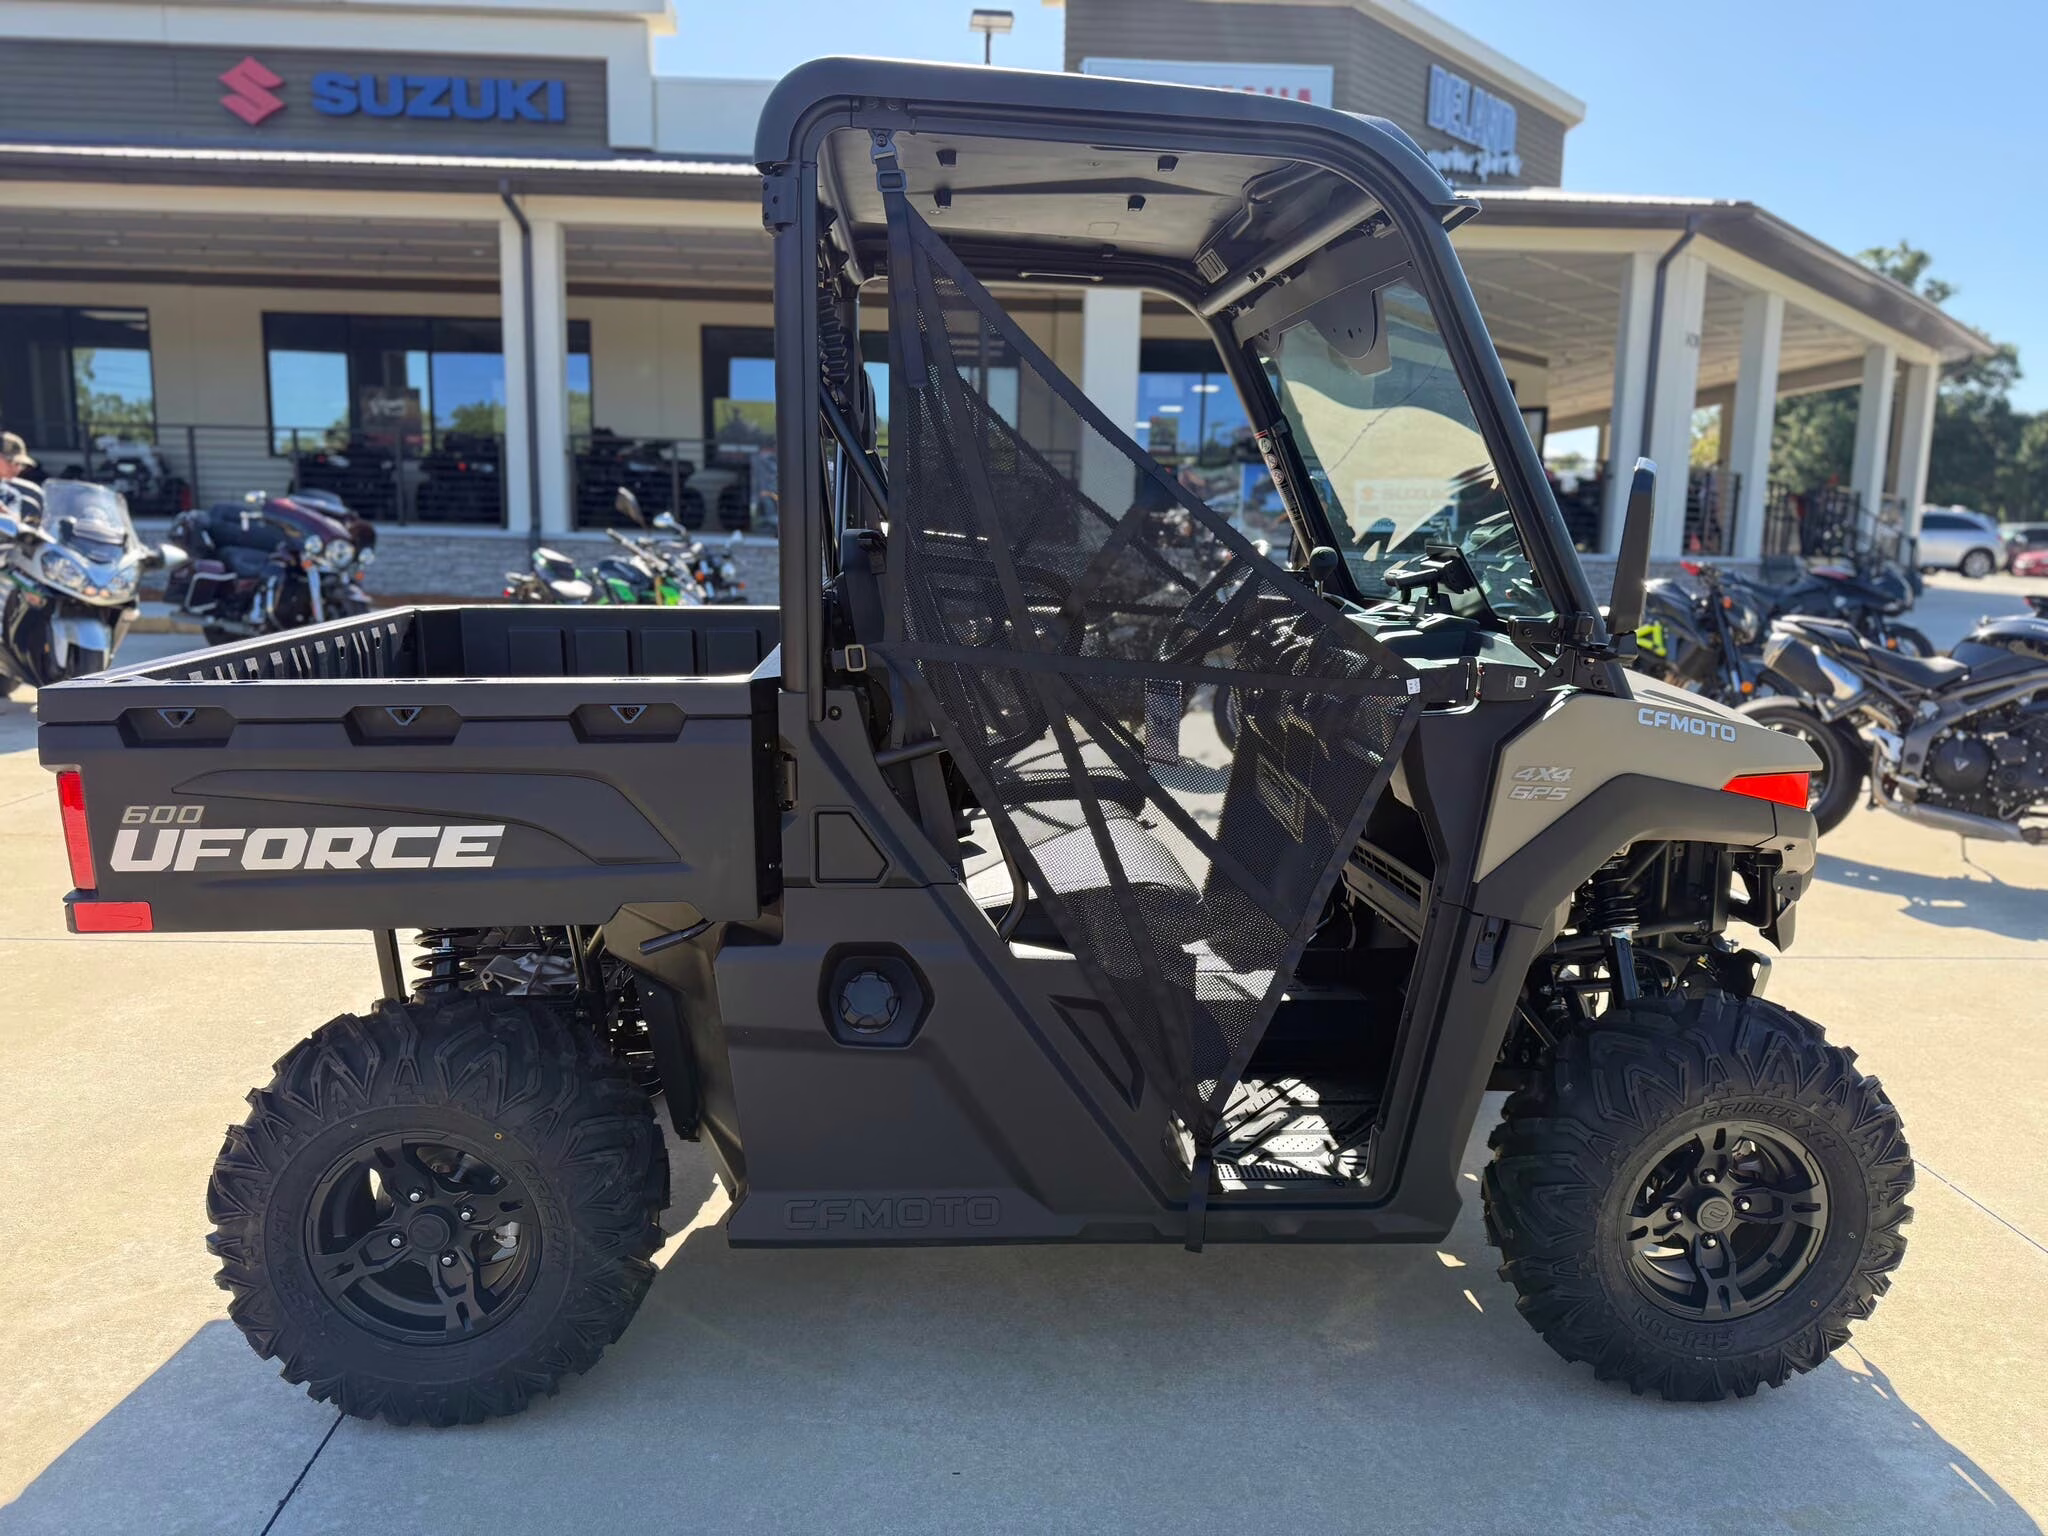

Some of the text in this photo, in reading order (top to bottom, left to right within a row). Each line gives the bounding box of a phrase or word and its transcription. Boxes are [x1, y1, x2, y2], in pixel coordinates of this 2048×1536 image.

[311, 71, 567, 123] SUZUKI
[1637, 706, 1737, 743] CFMOTO
[1513, 766, 1574, 783] 4X4
[121, 804, 205, 824] 600
[109, 824, 506, 872] UFORCE
[783, 1195, 1000, 1231] CFMOTO
